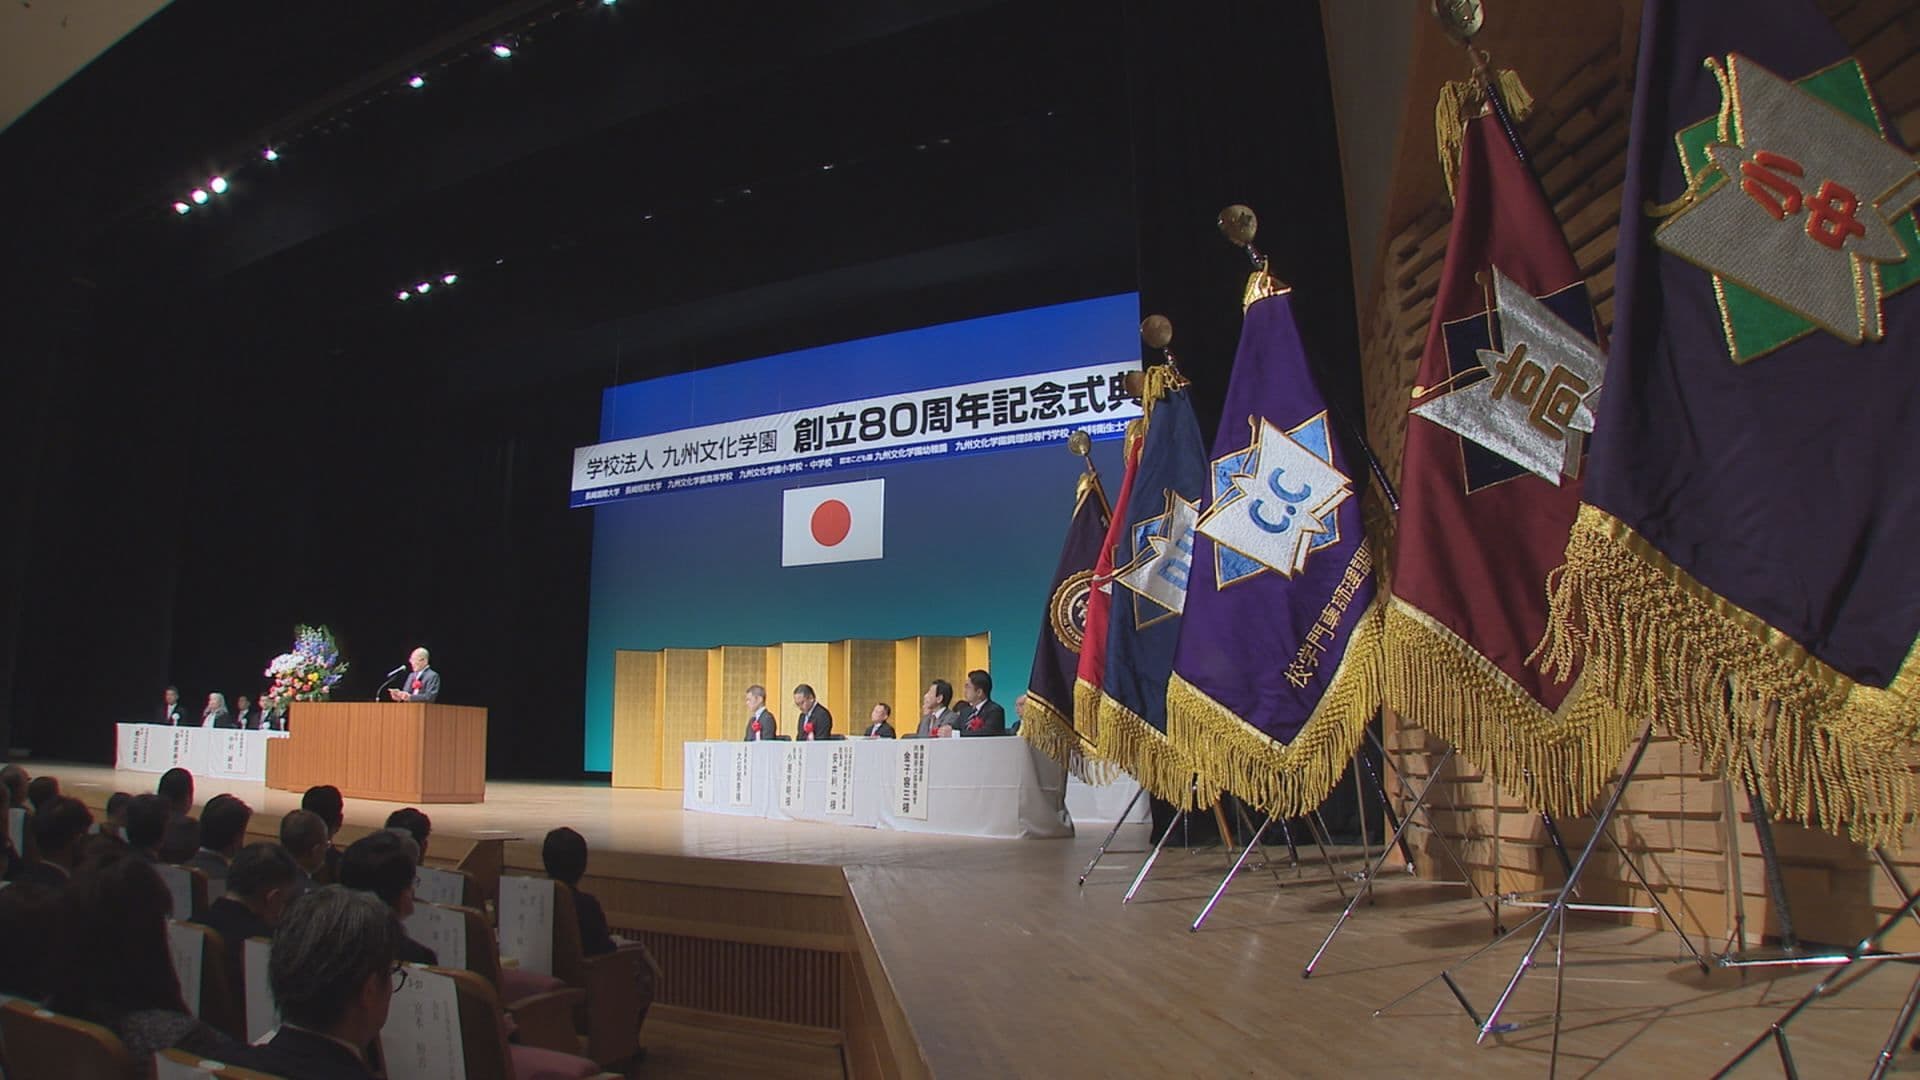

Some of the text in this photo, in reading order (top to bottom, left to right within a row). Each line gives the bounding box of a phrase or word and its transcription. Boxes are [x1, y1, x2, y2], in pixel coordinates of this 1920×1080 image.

[586, 371, 1142, 480] 学校法人 九州文化学園 創立80周年記念式典
